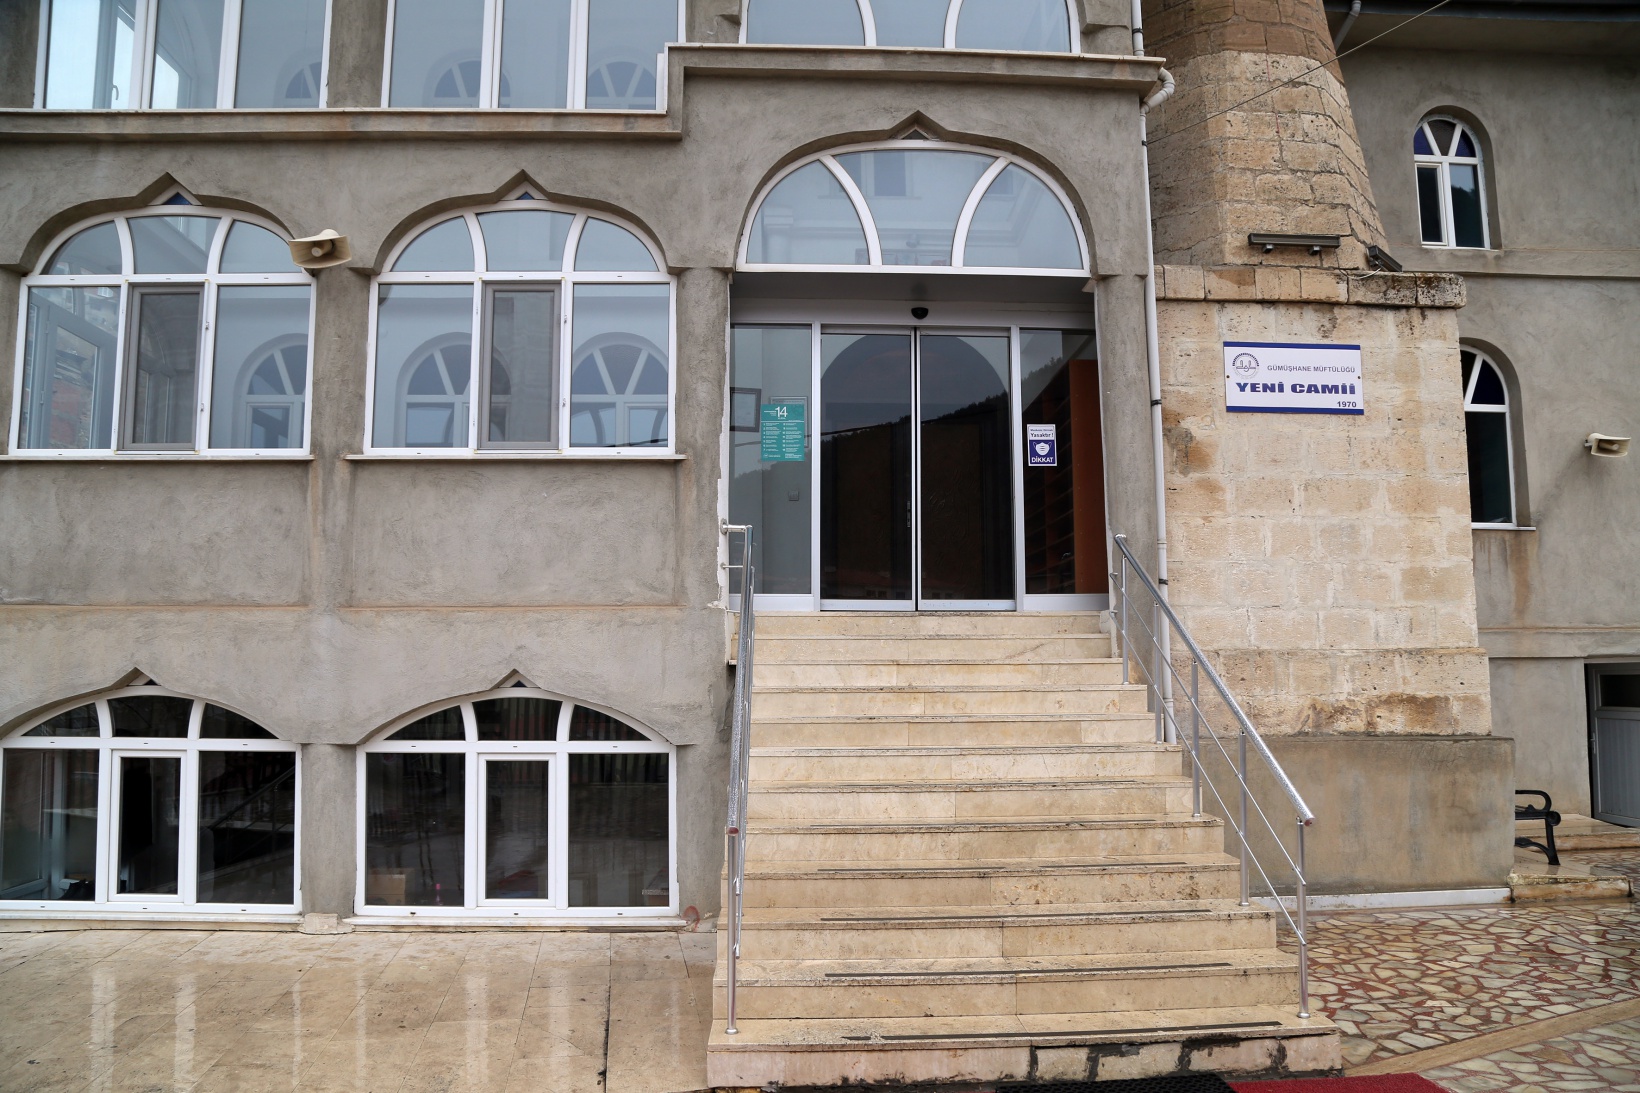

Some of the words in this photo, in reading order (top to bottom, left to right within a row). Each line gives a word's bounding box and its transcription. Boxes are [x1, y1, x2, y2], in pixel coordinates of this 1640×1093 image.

[1267, 364, 1312, 372] GÜMÜŞHANE
[1236, 382, 1285, 393] YENİ
[1290, 383, 1356, 395] CAMİİ
[775, 406, 788, 418] 14
[1031, 455, 1054, 463] DİKKAT
